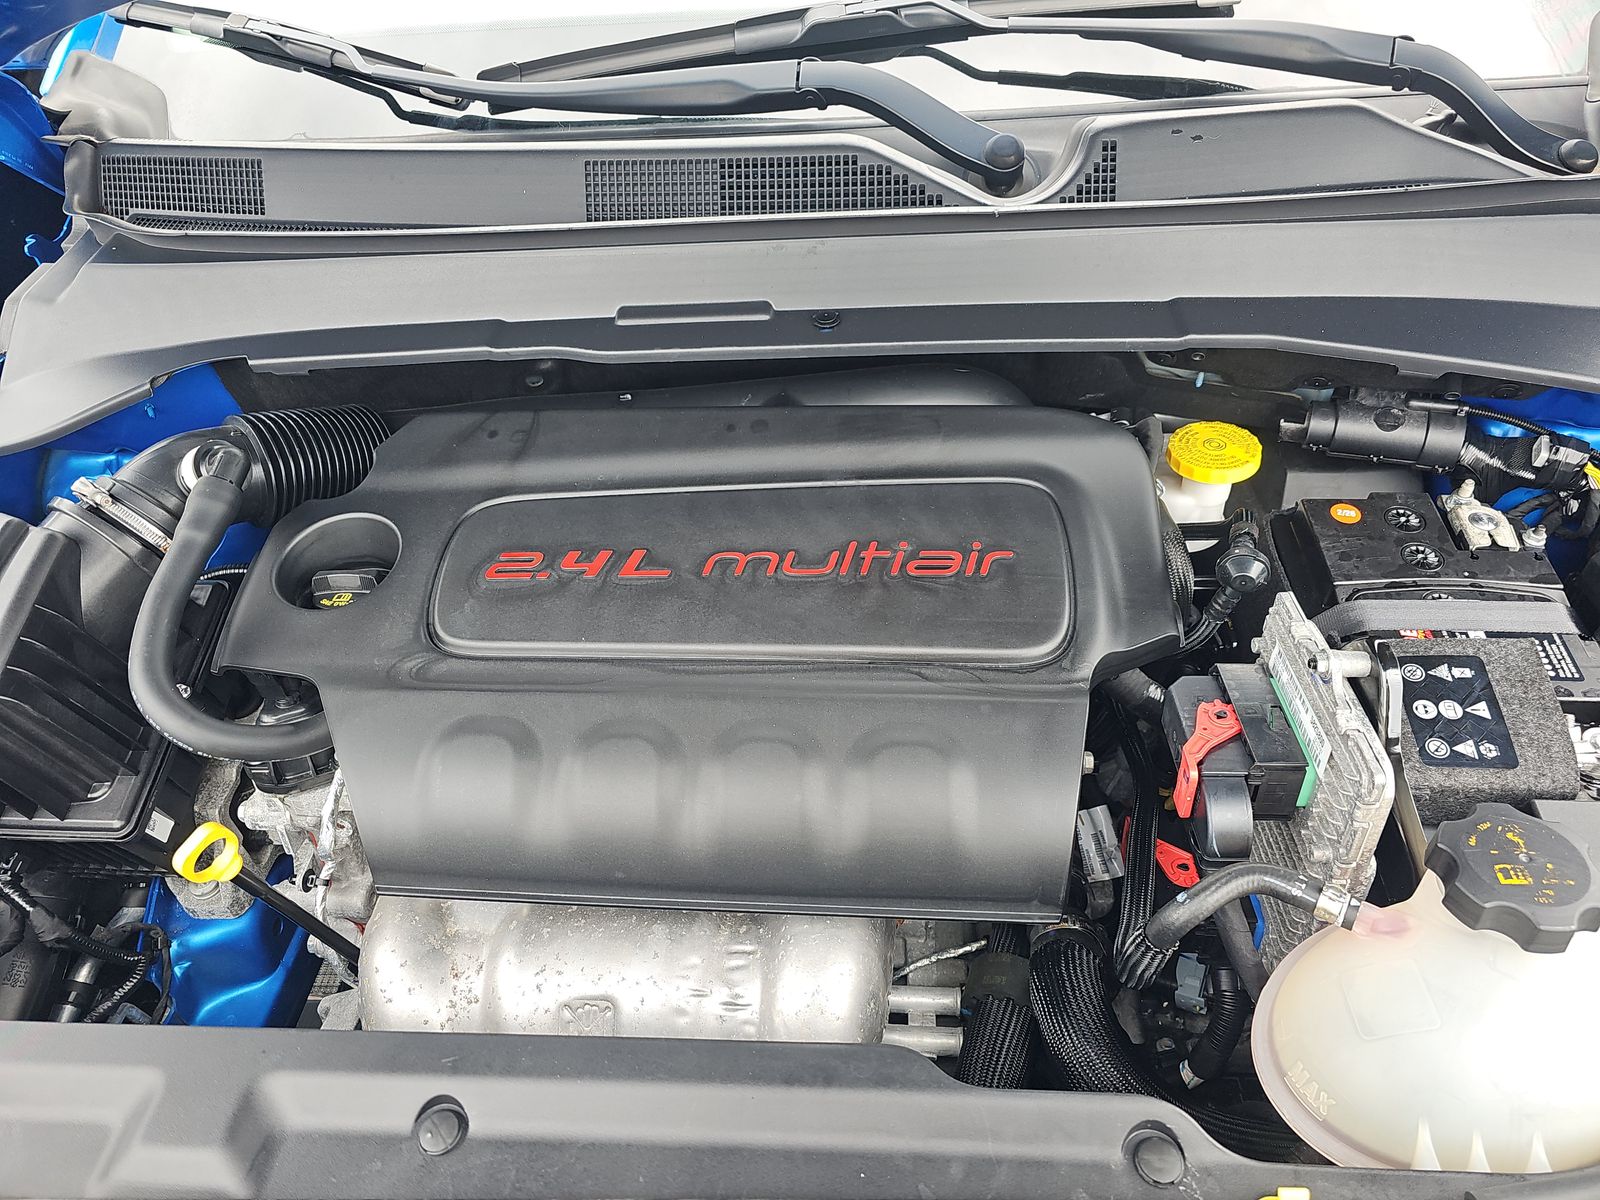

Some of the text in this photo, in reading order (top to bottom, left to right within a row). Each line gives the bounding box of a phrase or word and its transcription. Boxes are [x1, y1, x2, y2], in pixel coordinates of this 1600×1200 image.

[484, 539, 1014, 580] 2.4L multiair
[1287, 1060, 1336, 1116] MAX
